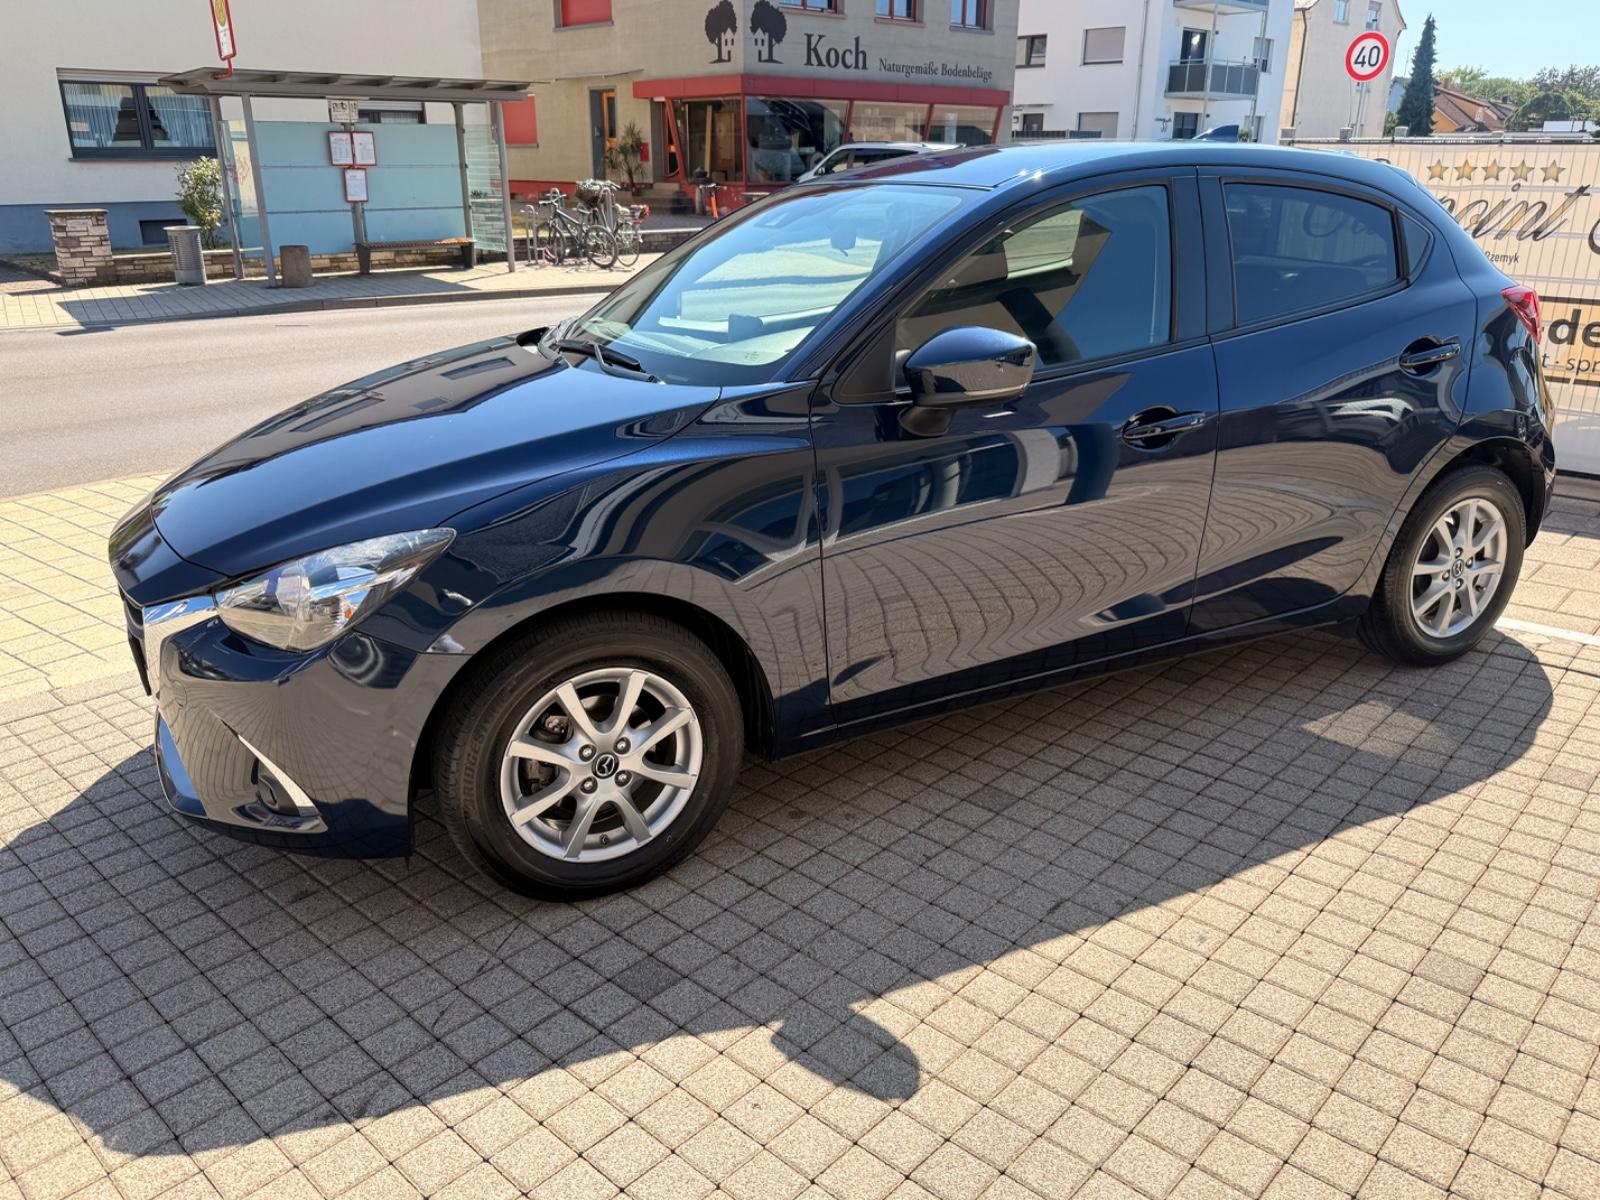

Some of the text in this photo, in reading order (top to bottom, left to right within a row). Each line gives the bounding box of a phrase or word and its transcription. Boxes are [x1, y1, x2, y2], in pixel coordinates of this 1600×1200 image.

[804, 33, 868, 70] Koch
[1354, 45, 1381, 67] 40
[879, 58, 992, 83] Naturgemäße Bodenbeläge
